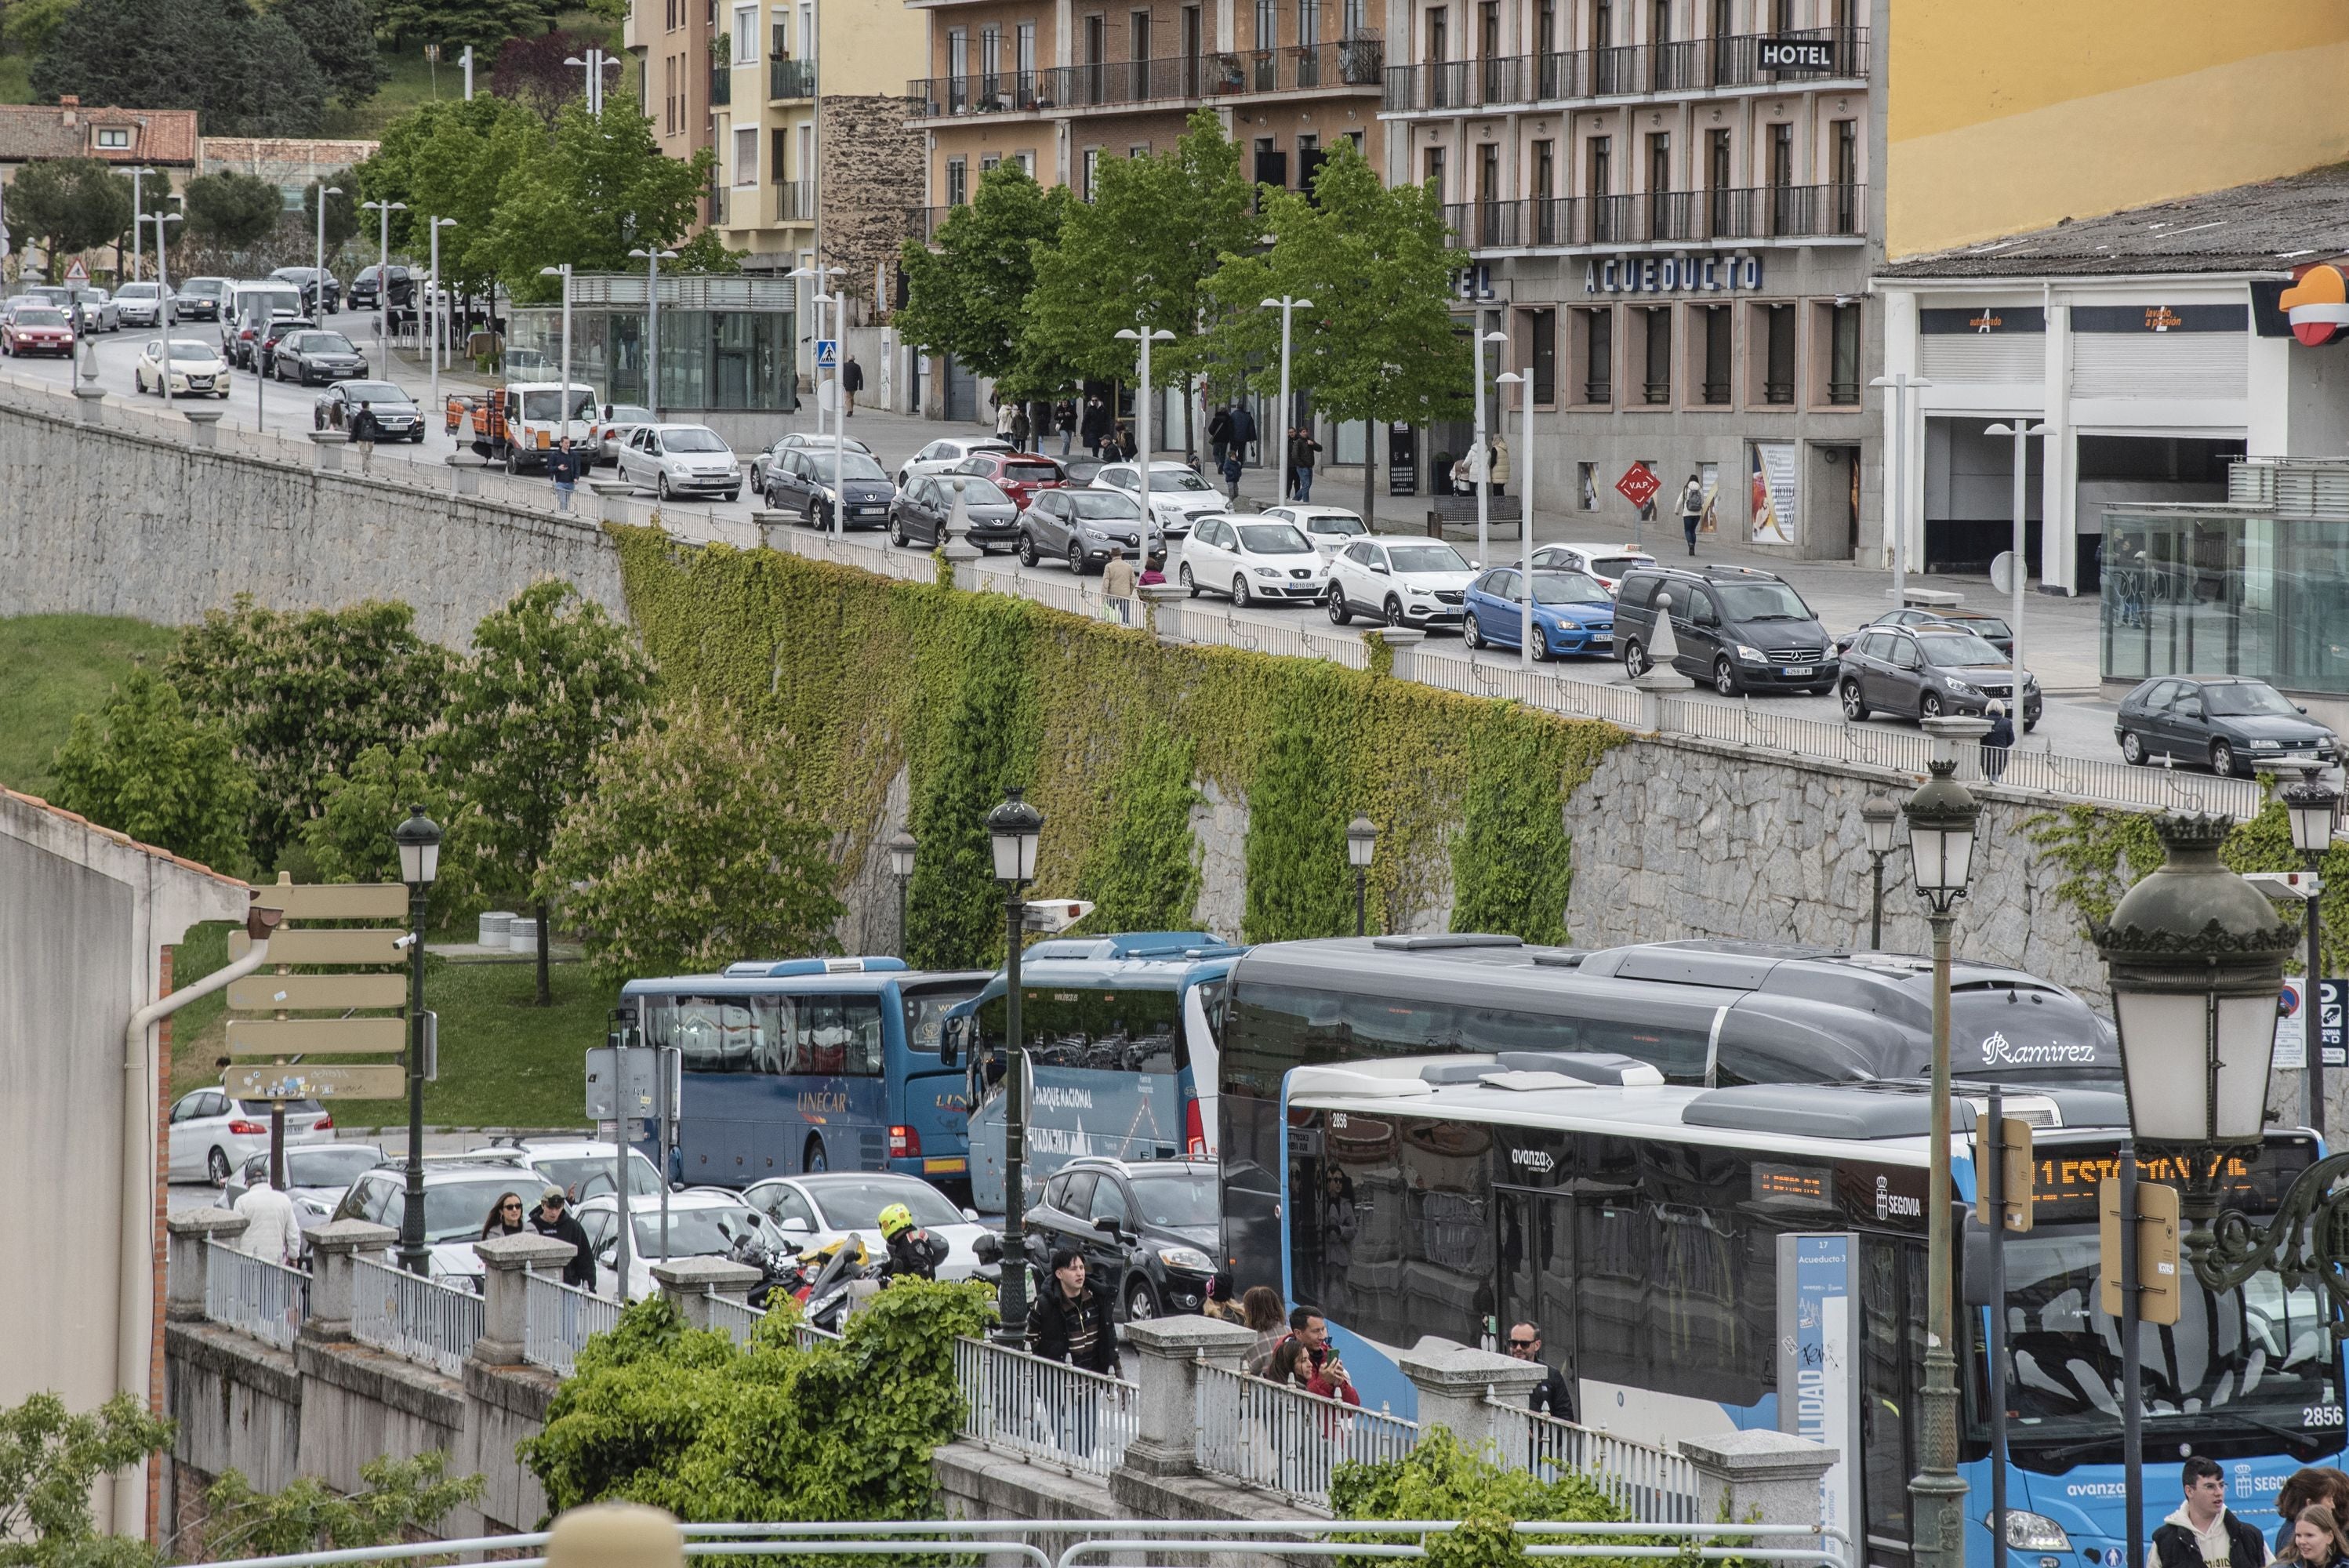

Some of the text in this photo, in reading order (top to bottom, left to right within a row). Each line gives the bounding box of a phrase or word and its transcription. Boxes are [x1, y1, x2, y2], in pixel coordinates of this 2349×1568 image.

[1763, 45, 1831, 64] HOTEL
[1585, 256, 1762, 293] ACUEDUCTO
[1982, 1031, 2095, 1065] Ramirez
[797, 1091, 847, 1113] LINECAR
[1036, 1087, 1093, 1113] PARQUE NACIONAL
[1333, 1112, 1348, 1129] 2856
[1512, 1149, 1546, 1167] avanza
[1888, 1195, 1921, 1217] SEGOVIA
[2303, 1406, 2344, 1427] 2856
[2067, 1483, 2126, 1497] avanza
